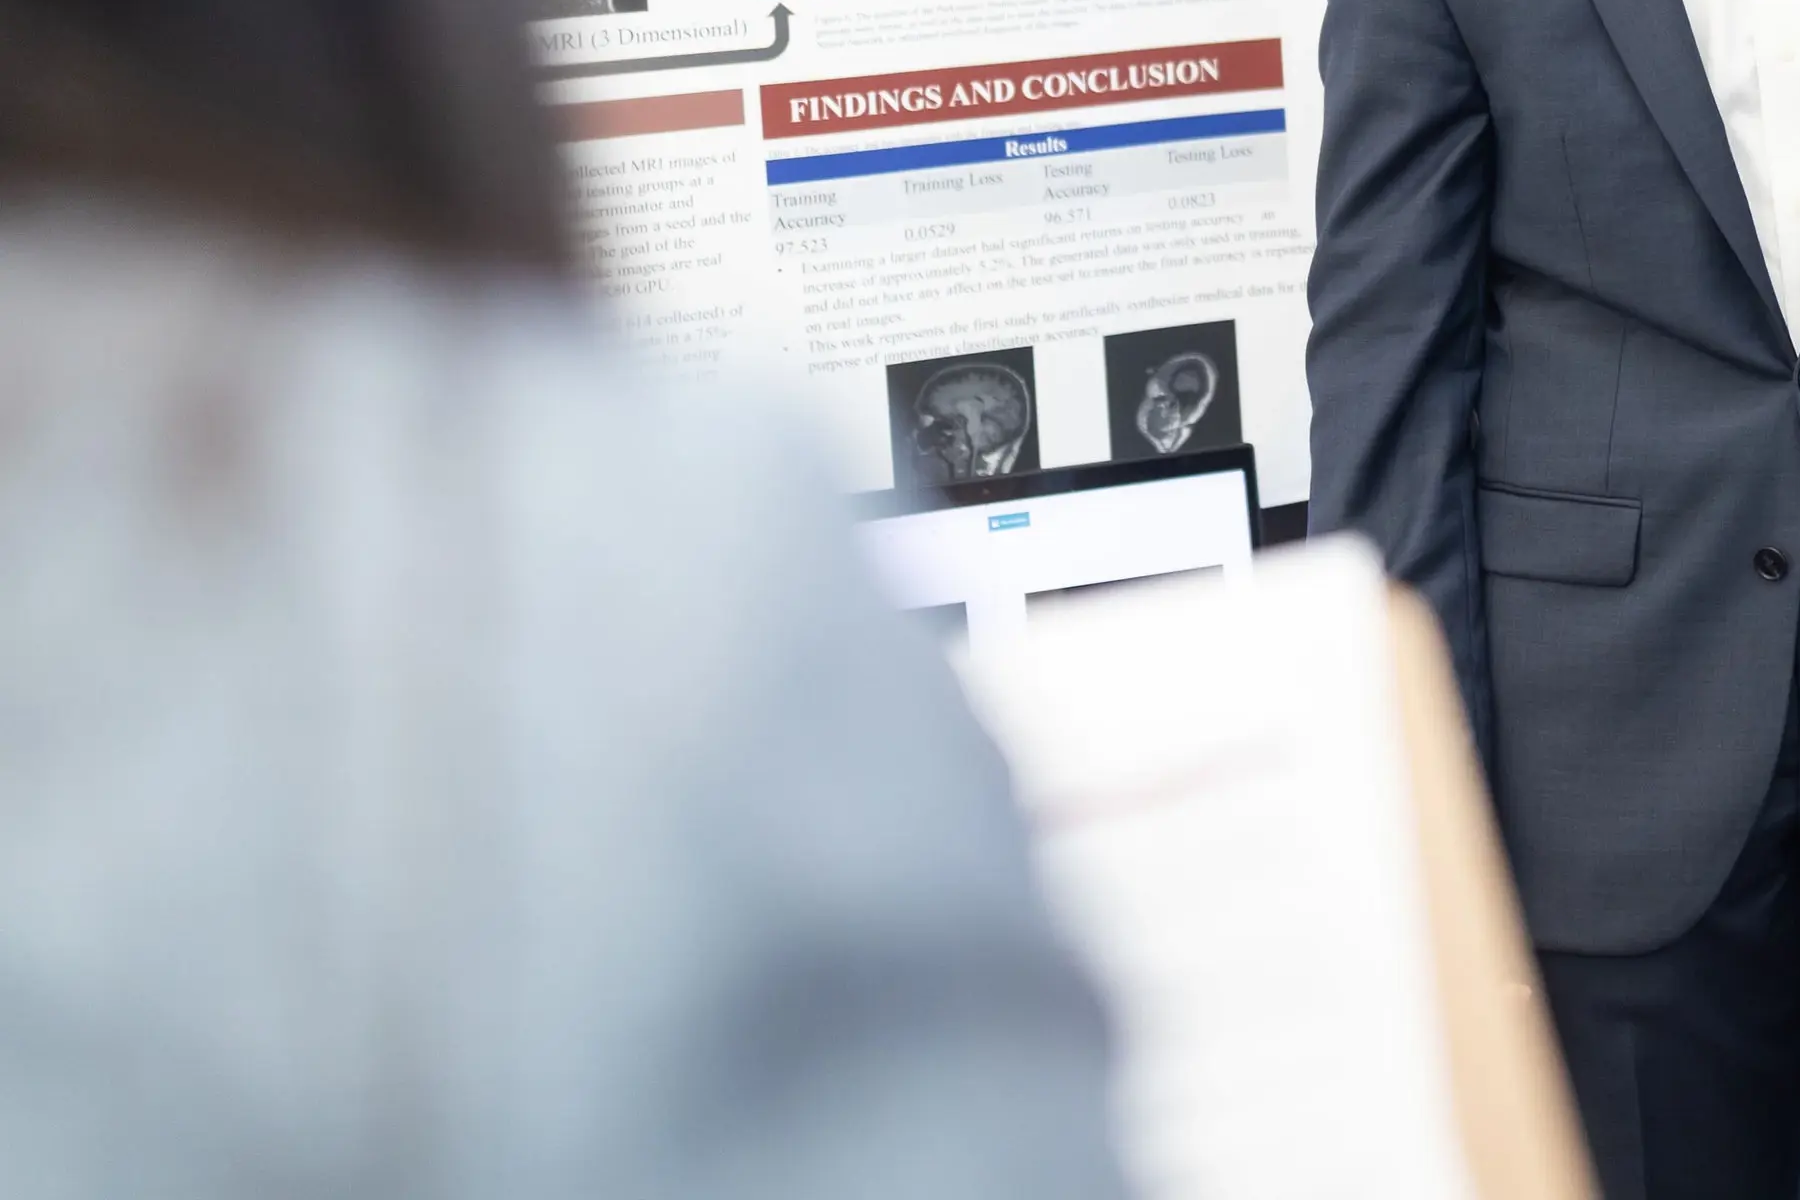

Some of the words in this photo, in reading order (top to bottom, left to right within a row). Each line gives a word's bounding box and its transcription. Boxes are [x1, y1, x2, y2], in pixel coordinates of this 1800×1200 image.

[541, 31, 582, 52] MRI
[591, 29, 610, 51] (3
[618, 18, 748, 46] Dimensional)
[789, 84, 944, 124] FINDINGS
[950, 77, 1016, 108] AND
[1022, 57, 1220, 101] CONCLUSION
[1005, 137, 1068, 157] Results
[1167, 148, 1216, 166] Testing
[1220, 144, 1253, 159] Loss
[631, 157, 664, 173] MRI
[722, 150, 737, 165] of
[1043, 161, 1093, 180] Testing
[586, 182, 634, 200] testing
[638, 178, 686, 196] groups
[902, 175, 964, 196] Training
[970, 172, 1004, 186] Loss
[1043, 181, 1111, 202] Accuracy
[669, 194, 695, 211] and
[773, 190, 838, 211] Training
[616, 222, 648, 237] from
[653, 222, 661, 233] a
[665, 215, 697, 231] seed
[700, 212, 726, 227] and
[774, 210, 846, 232] Accuracy
[904, 223, 956, 242] 0.0529
[620, 241, 651, 261] goal
[655, 238, 670, 252] of
[674, 236, 696, 250] the
[775, 237, 829, 256] 97.523
[617, 262, 667, 279] images
[669, 259, 692, 271] are
[696, 252, 723, 268] real
[803, 301, 829, 315] and
[832, 296, 855, 311] did
[804, 321, 822, 335] on
